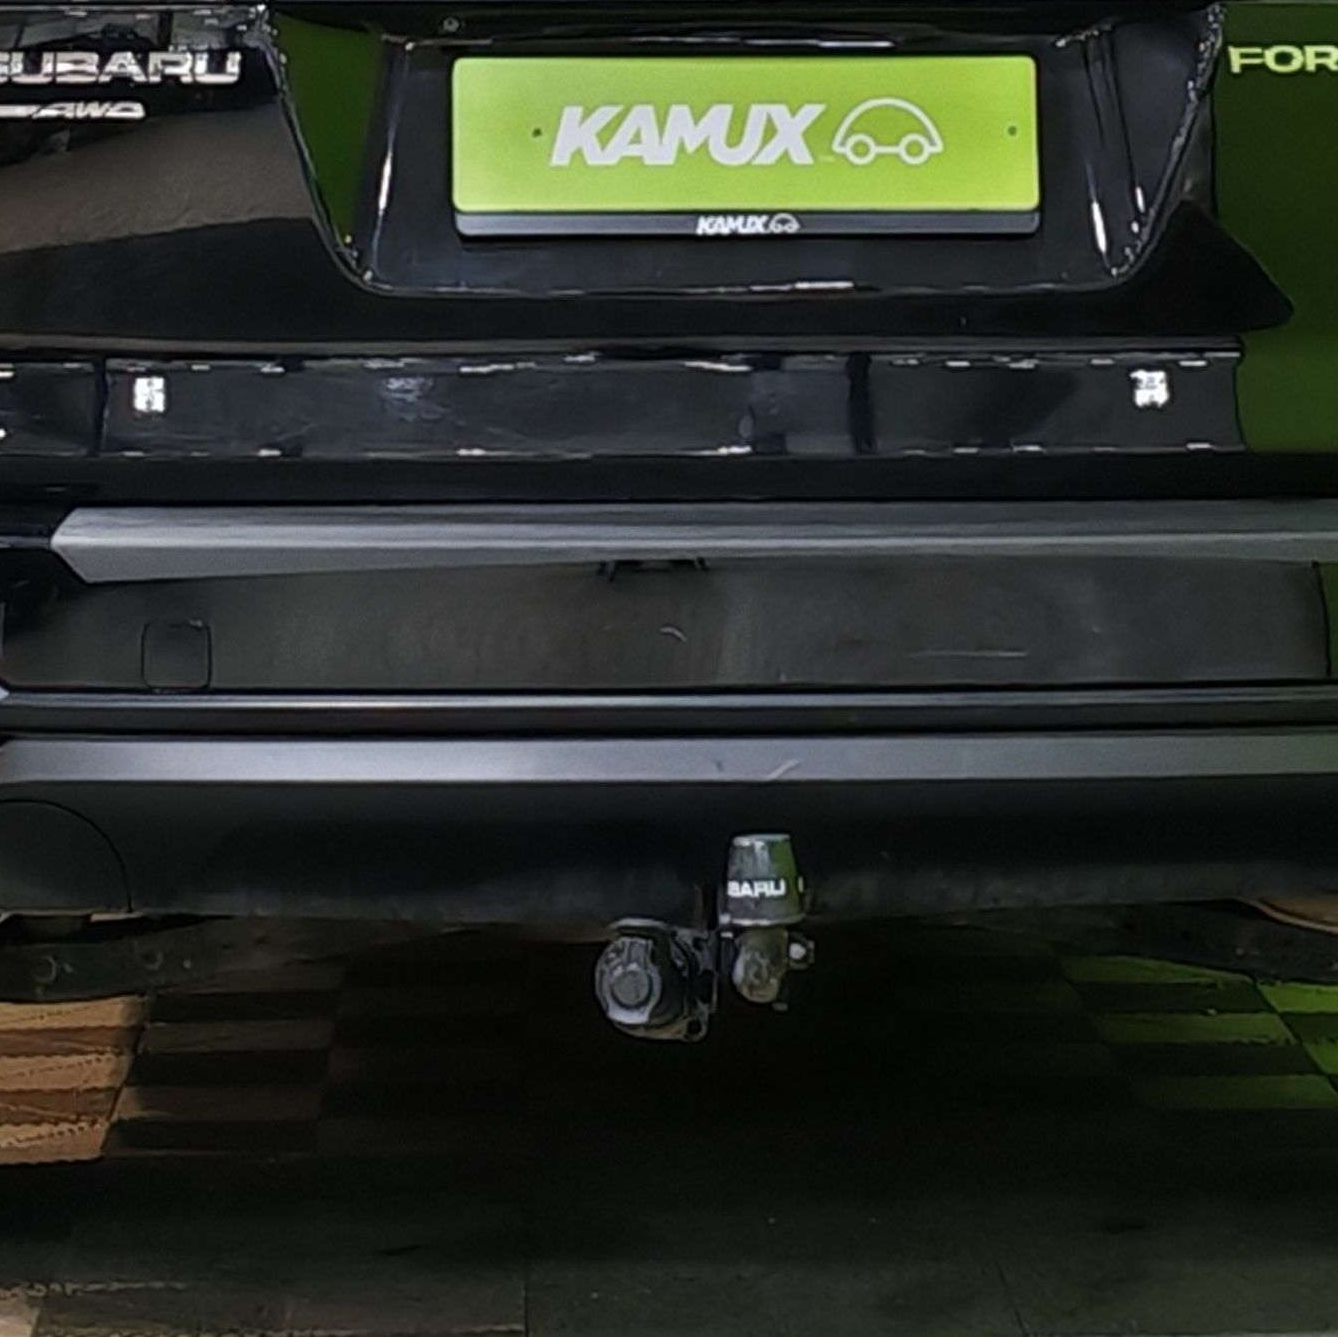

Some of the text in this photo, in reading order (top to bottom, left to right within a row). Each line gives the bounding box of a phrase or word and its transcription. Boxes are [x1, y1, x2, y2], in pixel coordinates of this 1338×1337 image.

[32, 101, 145, 120] AWD
[549, 103, 826, 167] KAMUX
[695, 214, 769, 236] KAMUX
